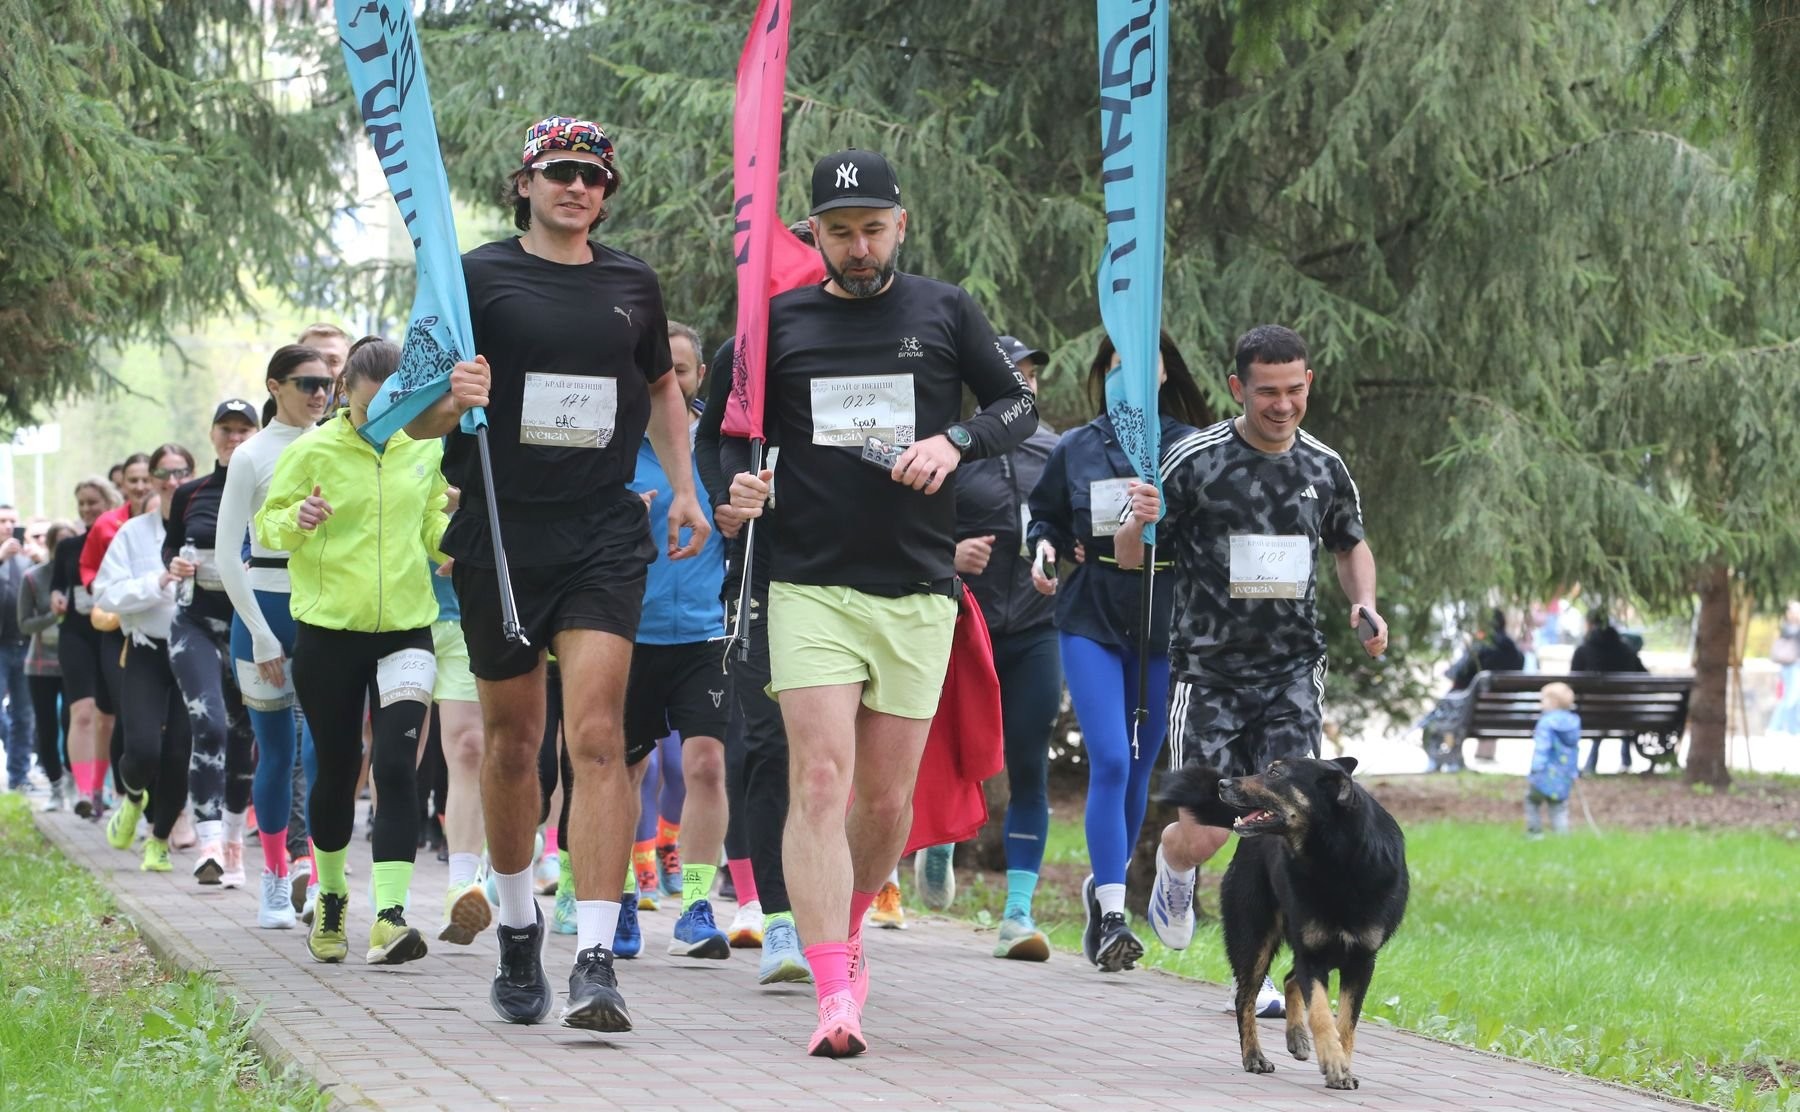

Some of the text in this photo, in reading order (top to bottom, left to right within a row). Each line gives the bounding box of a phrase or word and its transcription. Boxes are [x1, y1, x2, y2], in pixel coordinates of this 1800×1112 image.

[835, 162, 859, 189] NY
[560, 393, 590, 408] 174
[842, 393, 876, 410] 022
[1258, 550, 1286, 564] 108
[401, 660, 427, 671] 055
